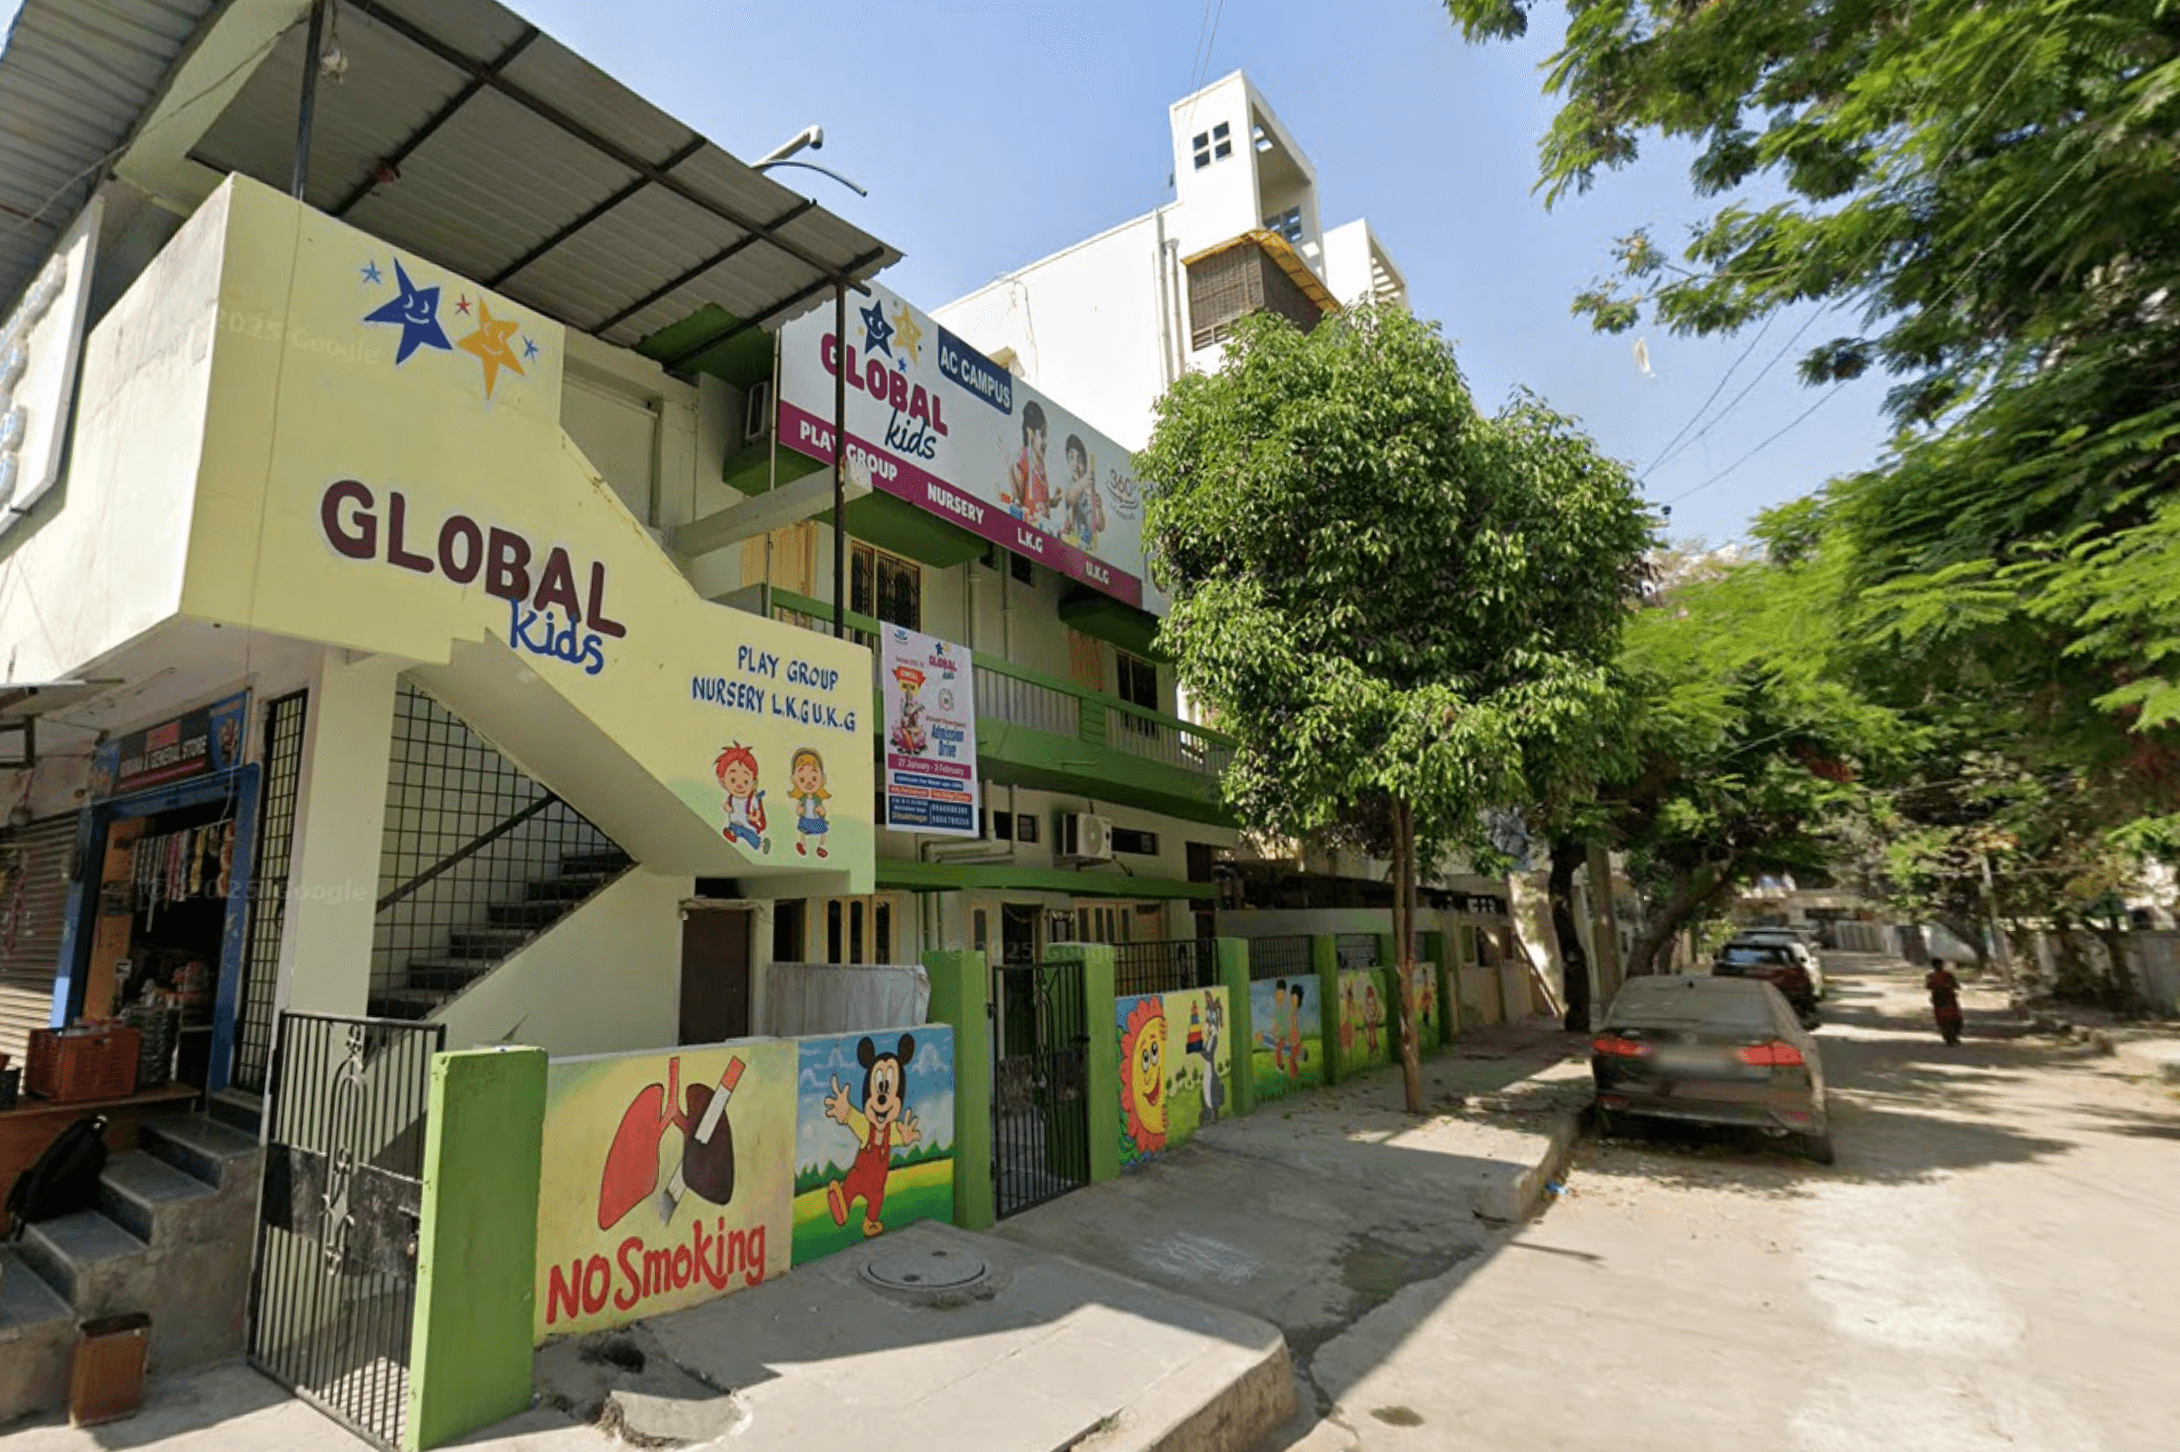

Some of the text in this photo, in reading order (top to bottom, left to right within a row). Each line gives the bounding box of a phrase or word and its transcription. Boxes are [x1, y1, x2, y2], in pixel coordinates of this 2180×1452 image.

[821, 332, 948, 437] GLOBAL
[940, 345, 1011, 409] AC CAMPUS
[884, 407, 937, 460] kids
[846, 443, 898, 482] GROUP
[926, 482, 986, 525] NURSERY
[321, 480, 627, 639] GLOBAL
[692, 676, 765, 714] NURSERY
[737, 645, 839, 692] PLAY GROUP
[545, 1216, 767, 1325] NO Smoking
